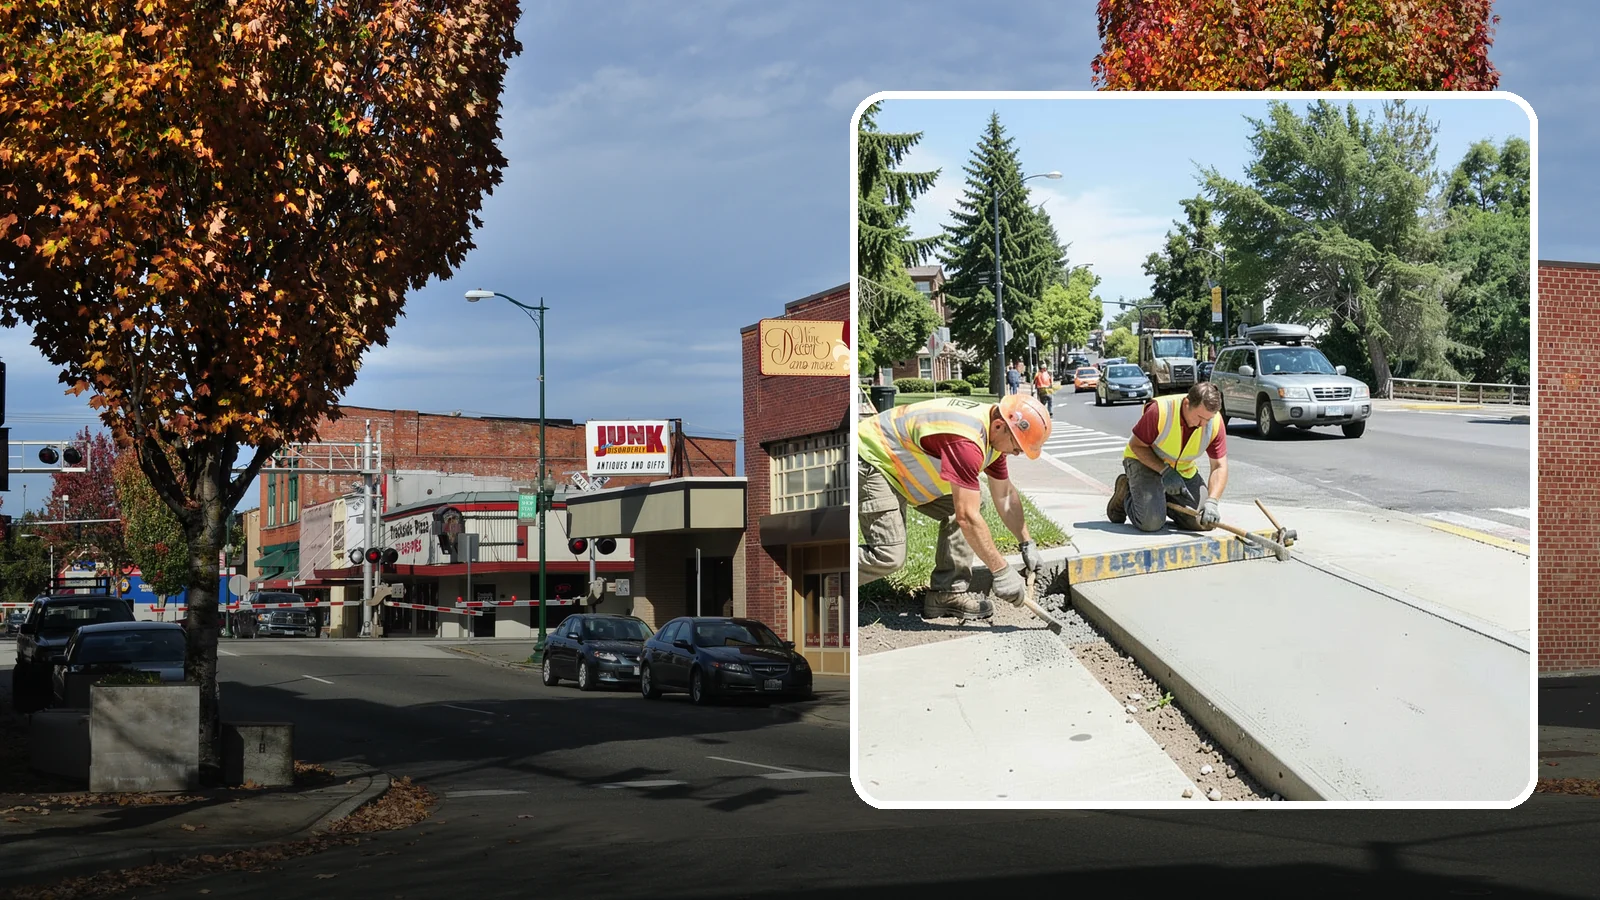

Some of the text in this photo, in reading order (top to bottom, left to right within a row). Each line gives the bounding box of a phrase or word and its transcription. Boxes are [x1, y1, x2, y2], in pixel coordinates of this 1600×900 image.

[596, 425, 664, 457] JUNK
[597, 461, 665, 470] ANTIQUES AND GIFTS
